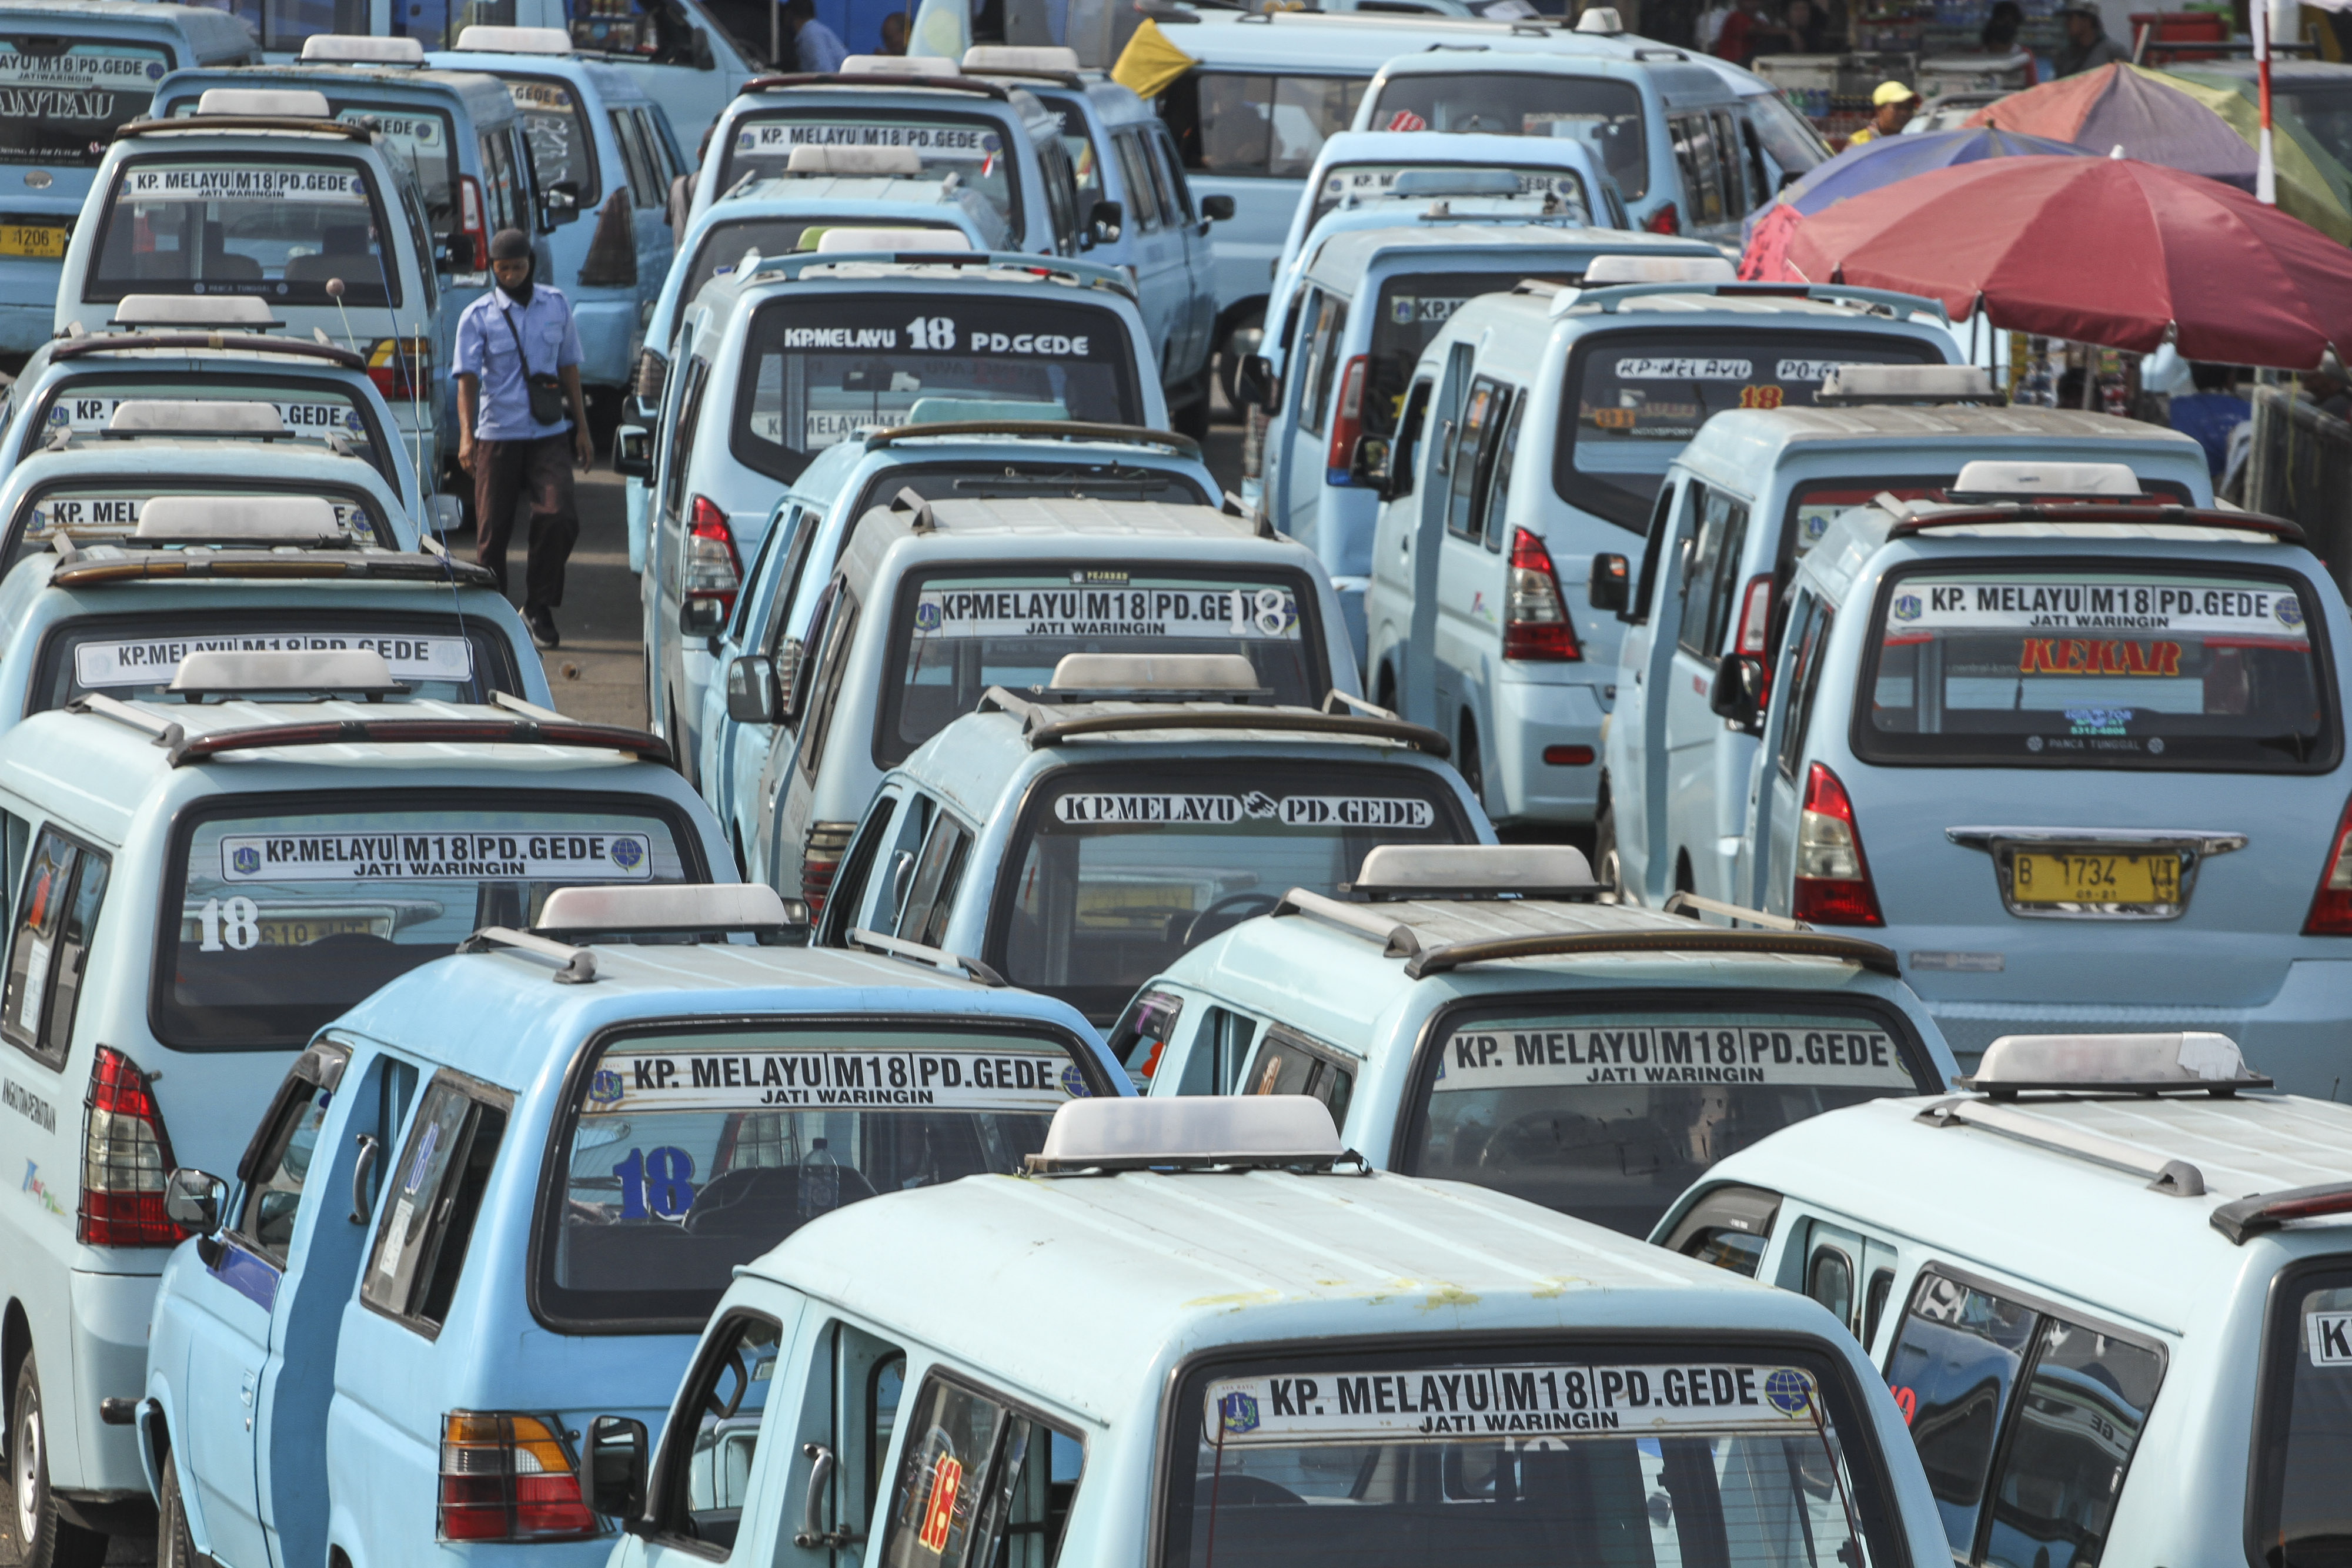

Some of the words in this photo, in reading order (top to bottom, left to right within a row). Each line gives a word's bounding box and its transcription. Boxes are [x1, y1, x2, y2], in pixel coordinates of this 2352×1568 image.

[38, 56, 73, 72] M18
[79, 59, 142, 76] PD.GEDE
[761, 128, 783, 145] KP.
[790, 128, 856, 145] MELAYU
[863, 130, 900, 146] M18
[907, 133, 978, 149] PD.GEDE
[138, 175, 159, 190] KP.
[165, 173, 230, 190] MELAYU
[236, 173, 272, 190] M18
[279, 175, 348, 192] PD.GEDE
[230, 190, 285, 198] WARINGIN
[18, 228, 49, 246] 1206
[906, 317, 956, 350] 18
[971, 332, 1089, 355] PD.GEDE
[1739, 385, 1783, 409] 18
[76, 400, 103, 420] KP.
[278, 404, 341, 426] .GEDE
[54, 502, 83, 523] KP.
[93, 502, 139, 523] MEL
[1087, 593, 1145, 620] M18
[1227, 588, 1287, 636] 18
[1932, 587, 1967, 611] KP.
[1977, 588, 2080, 613] MELAYU
[2091, 589, 2149, 614] M18
[2160, 590, 2269, 618] PD.GEDE
[1025, 622, 1065, 634] JATI
[1073, 622, 1165, 635] WARINGIN
[2030, 615, 2070, 627] JATI
[2076, 615, 2169, 628] WARINGIN
[2018, 638, 2182, 676] KEKAR
[2049, 738, 2084, 749] PANCA
[2090, 739, 2141, 751] TUNGGAL
[1065, 797, 1235, 822] KP.MELAYU
[1286, 799, 1426, 825] PD.GEDE
[404, 837, 469, 861] M18
[477, 837, 606, 860] PD.GEDE
[353, 863, 402, 875] JATI
[411, 862, 525, 875] WARINGIN
[2019, 857, 2033, 884] B
[2062, 857, 2116, 886] 1734
[198, 894, 259, 952] 18
[1455, 1035, 1502, 1069] KP.
[1514, 1031, 1649, 1066] MELAYU
[1660, 1031, 1738, 1064] M18
[1748, 1032, 1889, 1067] PD.GEDE
[634, 1059, 680, 1089] KP.
[691, 1058, 822, 1088] MELAYU
[834, 1057, 907, 1088] M18
[918, 1057, 1055, 1090] PD.GEDE
[1586, 1067, 1637, 1082] JATI
[1643, 1066, 1764, 1082] WARINGIN
[760, 1089, 810, 1104] JATI
[819, 1089, 934, 1104] WARINGIN
[613, 1146, 696, 1222] 18
[1269, 1378, 1324, 1416] KP.
[1336, 1373, 1489, 1415] MELAYU
[1501, 1370, 1589, 1410] M18
[1599, 1368, 1759, 1408] PD.GEDE
[1418, 1415, 1475, 1433] JATI
[1484, 1412, 1619, 1432] WARINGIN
[918, 1450, 963, 1556] 18
